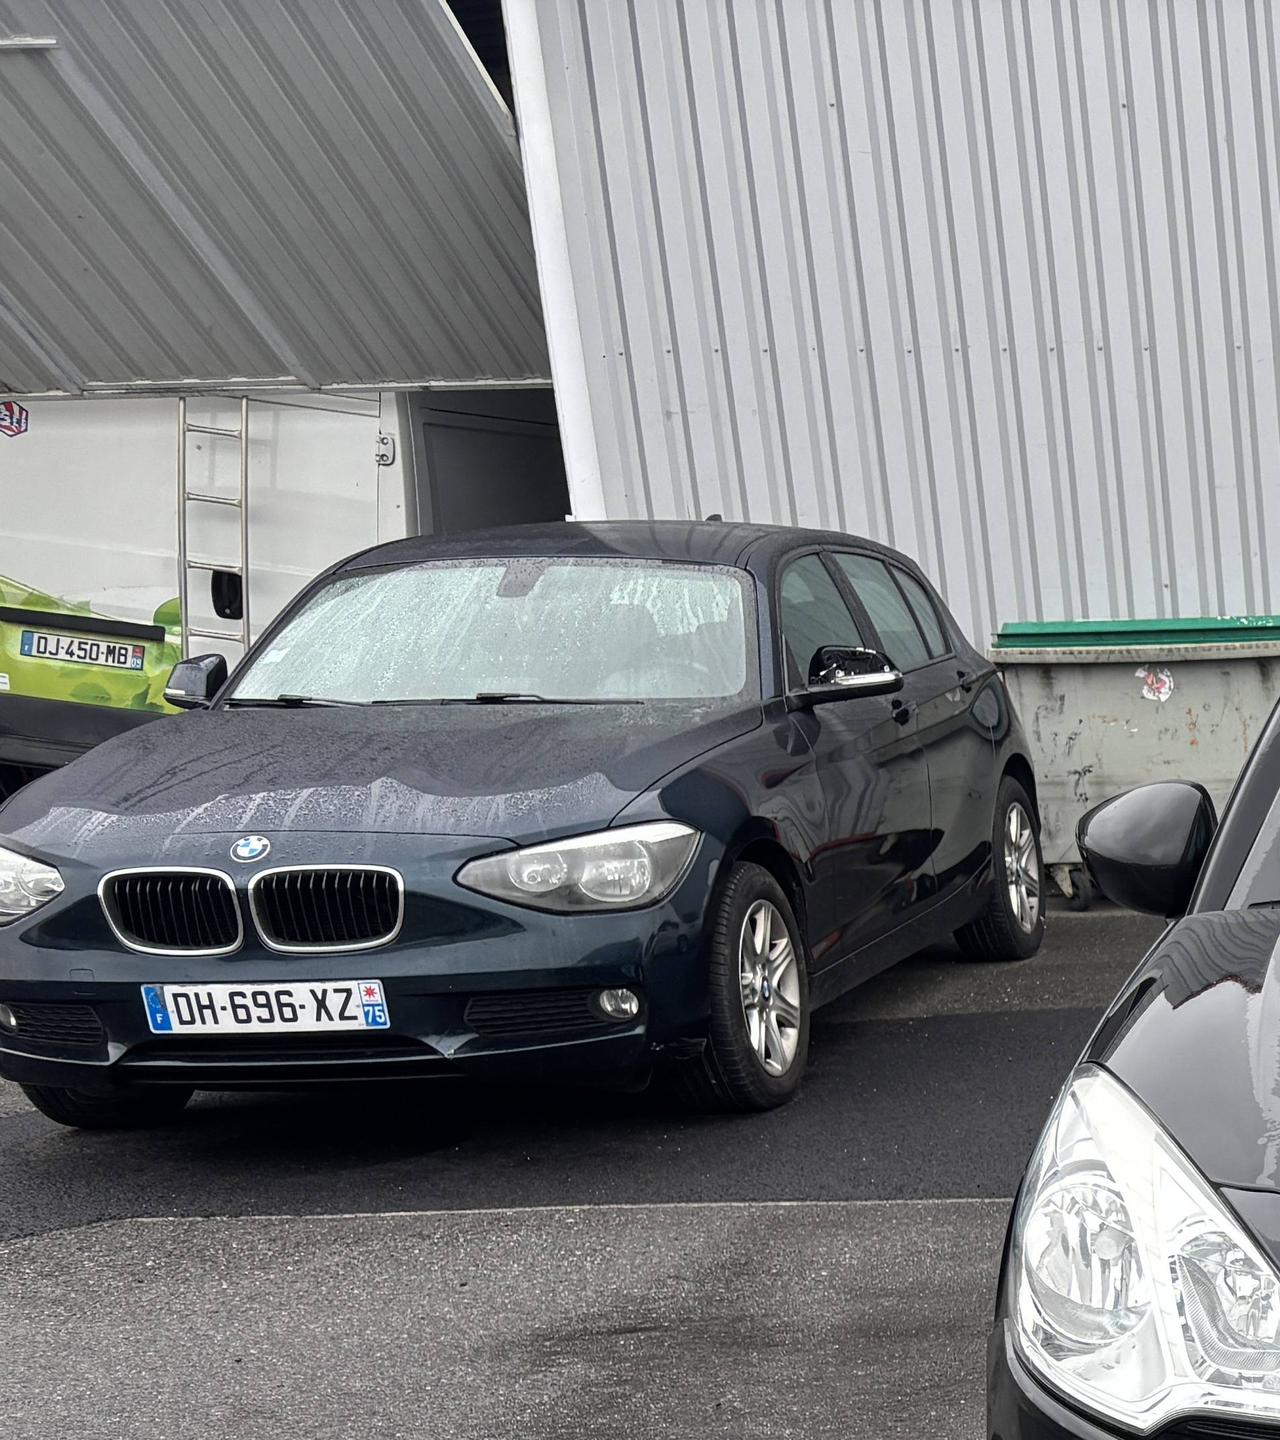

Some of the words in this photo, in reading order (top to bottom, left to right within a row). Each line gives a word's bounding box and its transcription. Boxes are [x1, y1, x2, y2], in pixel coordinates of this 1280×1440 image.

[36, 635, 128, 665] DJ-450-MB
[171, 988, 359, 1025] DH-696-XZ
[364, 1006, 386, 1023] 75
[155, 1013, 164, 1025] F
